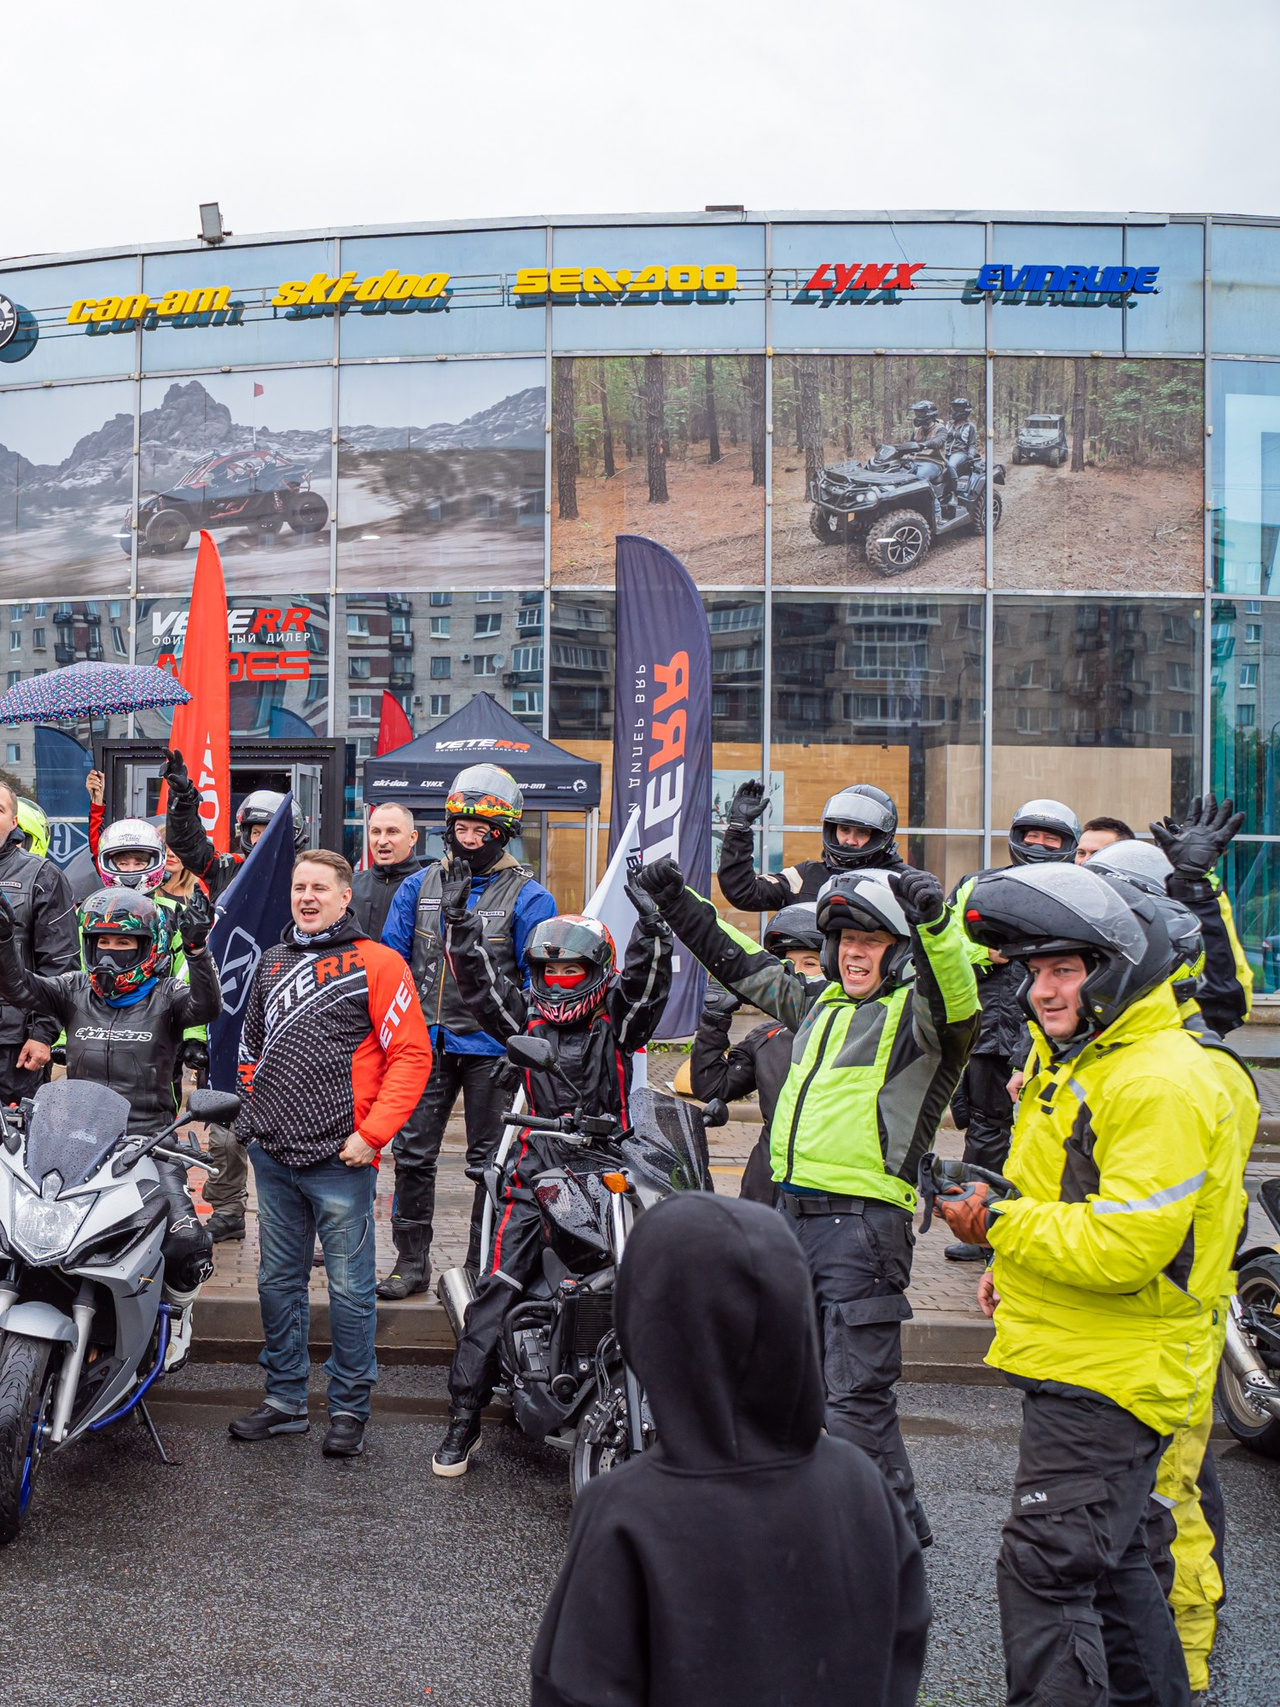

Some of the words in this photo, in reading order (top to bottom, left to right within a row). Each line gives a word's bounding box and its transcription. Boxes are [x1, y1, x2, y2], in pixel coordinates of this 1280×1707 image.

[271, 269, 450, 306] ski-doo
[805, 262, 927, 293] LYNX
[977, 264, 1162, 295] EVINRUDE
[67, 284, 232, 325] can-am
[152, 608, 312, 636] VEERR
[266, 632, 311, 644] ДИЛЕР
[435, 738, 531, 751] VETERR
[372, 779, 410, 787] ski-doo
[75, 1026, 153, 1042] alpinestars
